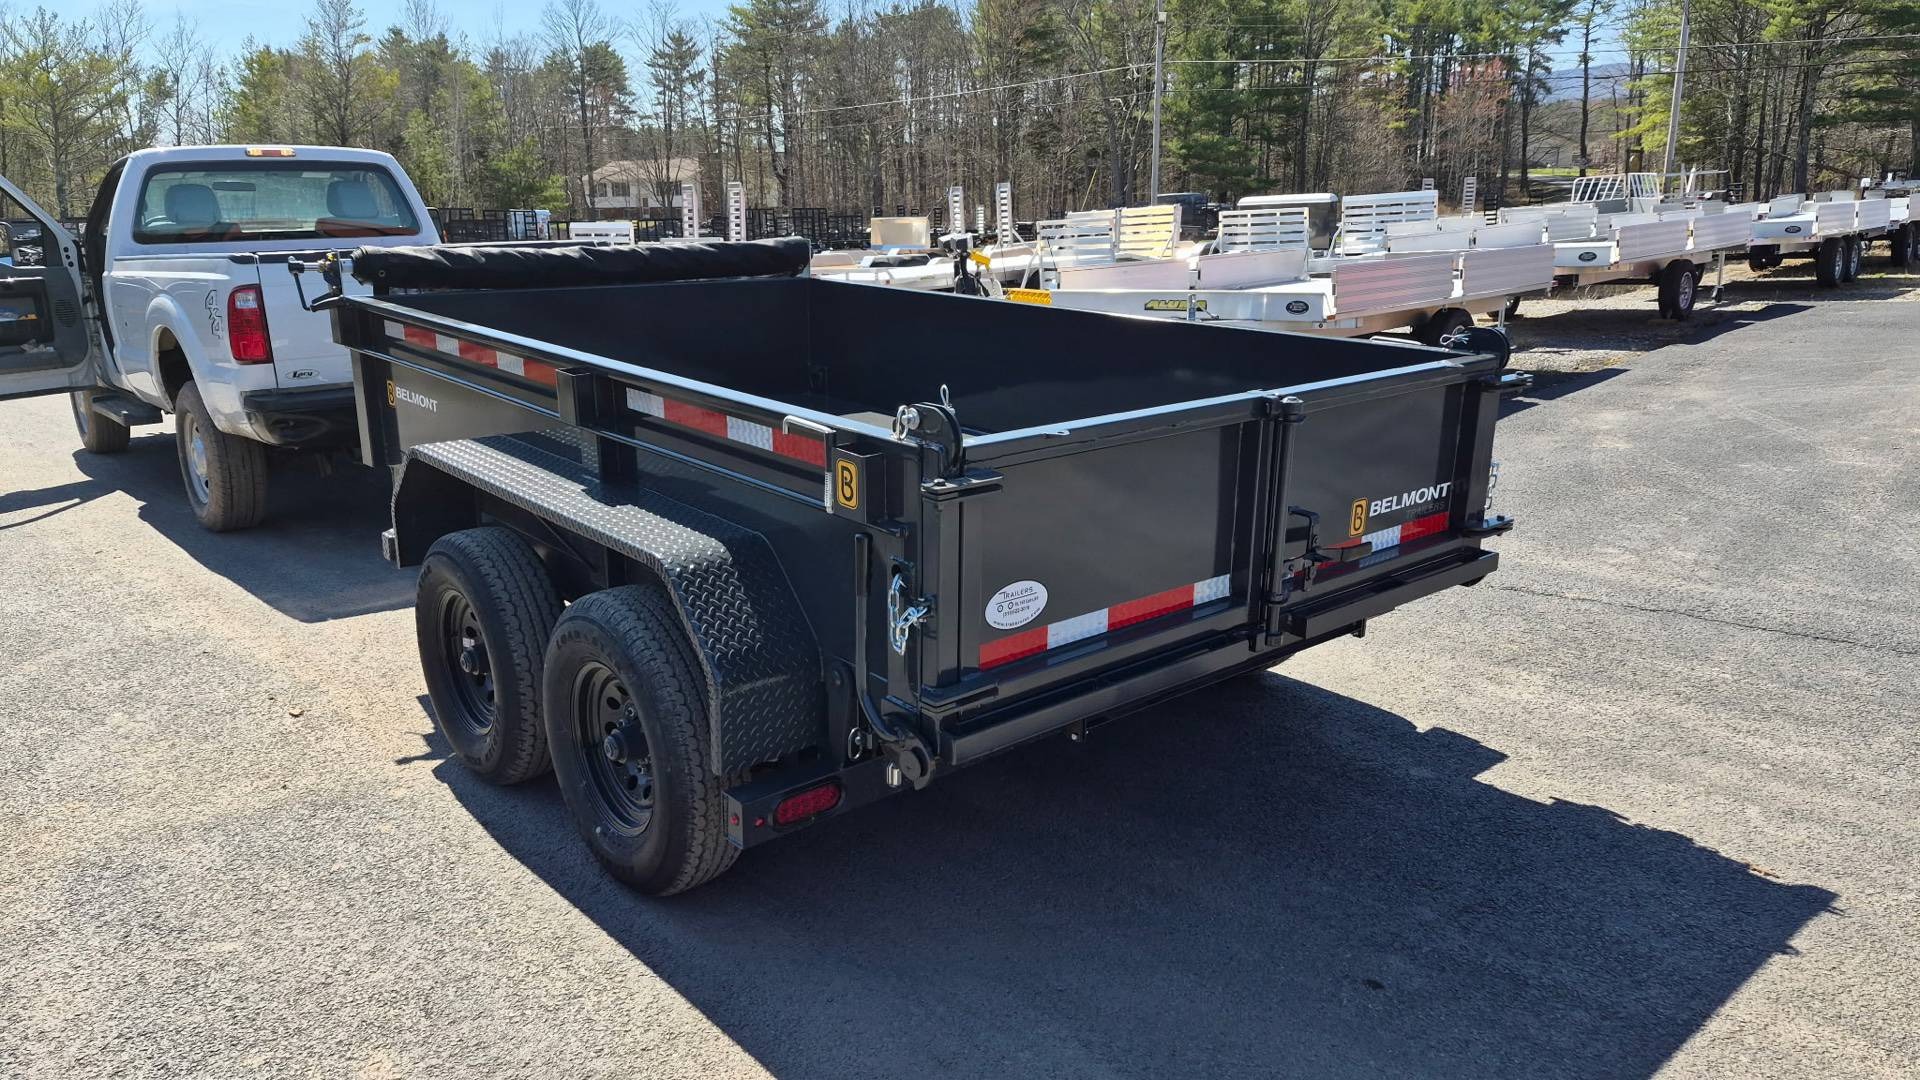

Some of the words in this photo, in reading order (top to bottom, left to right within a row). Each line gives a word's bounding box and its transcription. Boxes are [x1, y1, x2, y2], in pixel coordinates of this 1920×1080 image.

[395, 386, 438, 413] BELMONT
[840, 465, 854, 502] B
[1369, 482, 1452, 518] BELMONT
[998, 586, 1033, 600] TRAILERS
